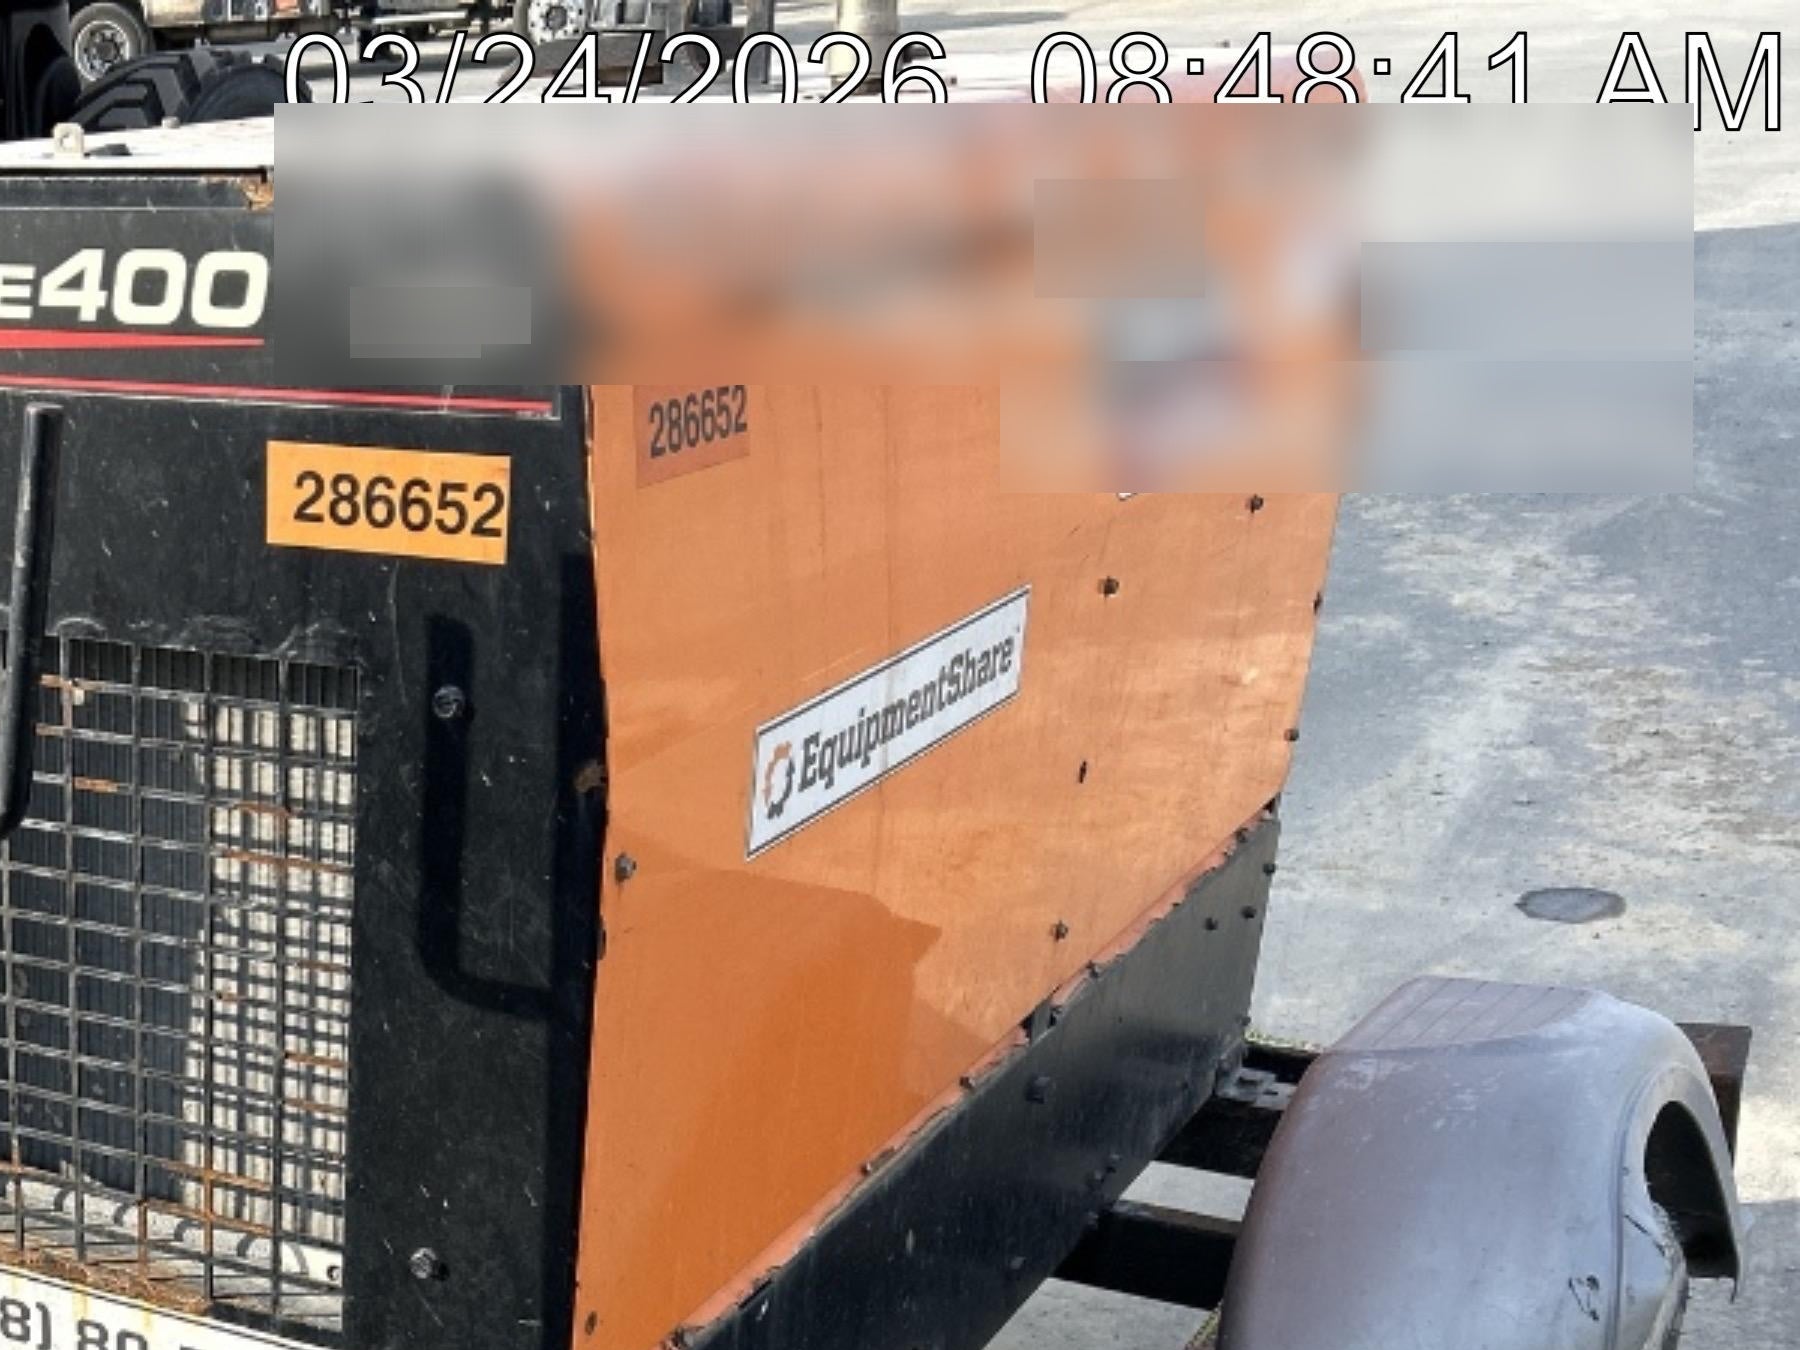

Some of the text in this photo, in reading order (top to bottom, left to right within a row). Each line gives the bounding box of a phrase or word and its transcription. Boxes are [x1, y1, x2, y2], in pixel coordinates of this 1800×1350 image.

[648, 384, 749, 460] 286652
[293, 469, 506, 538] 286652
[798, 635, 1015, 792] EquipmentShare
